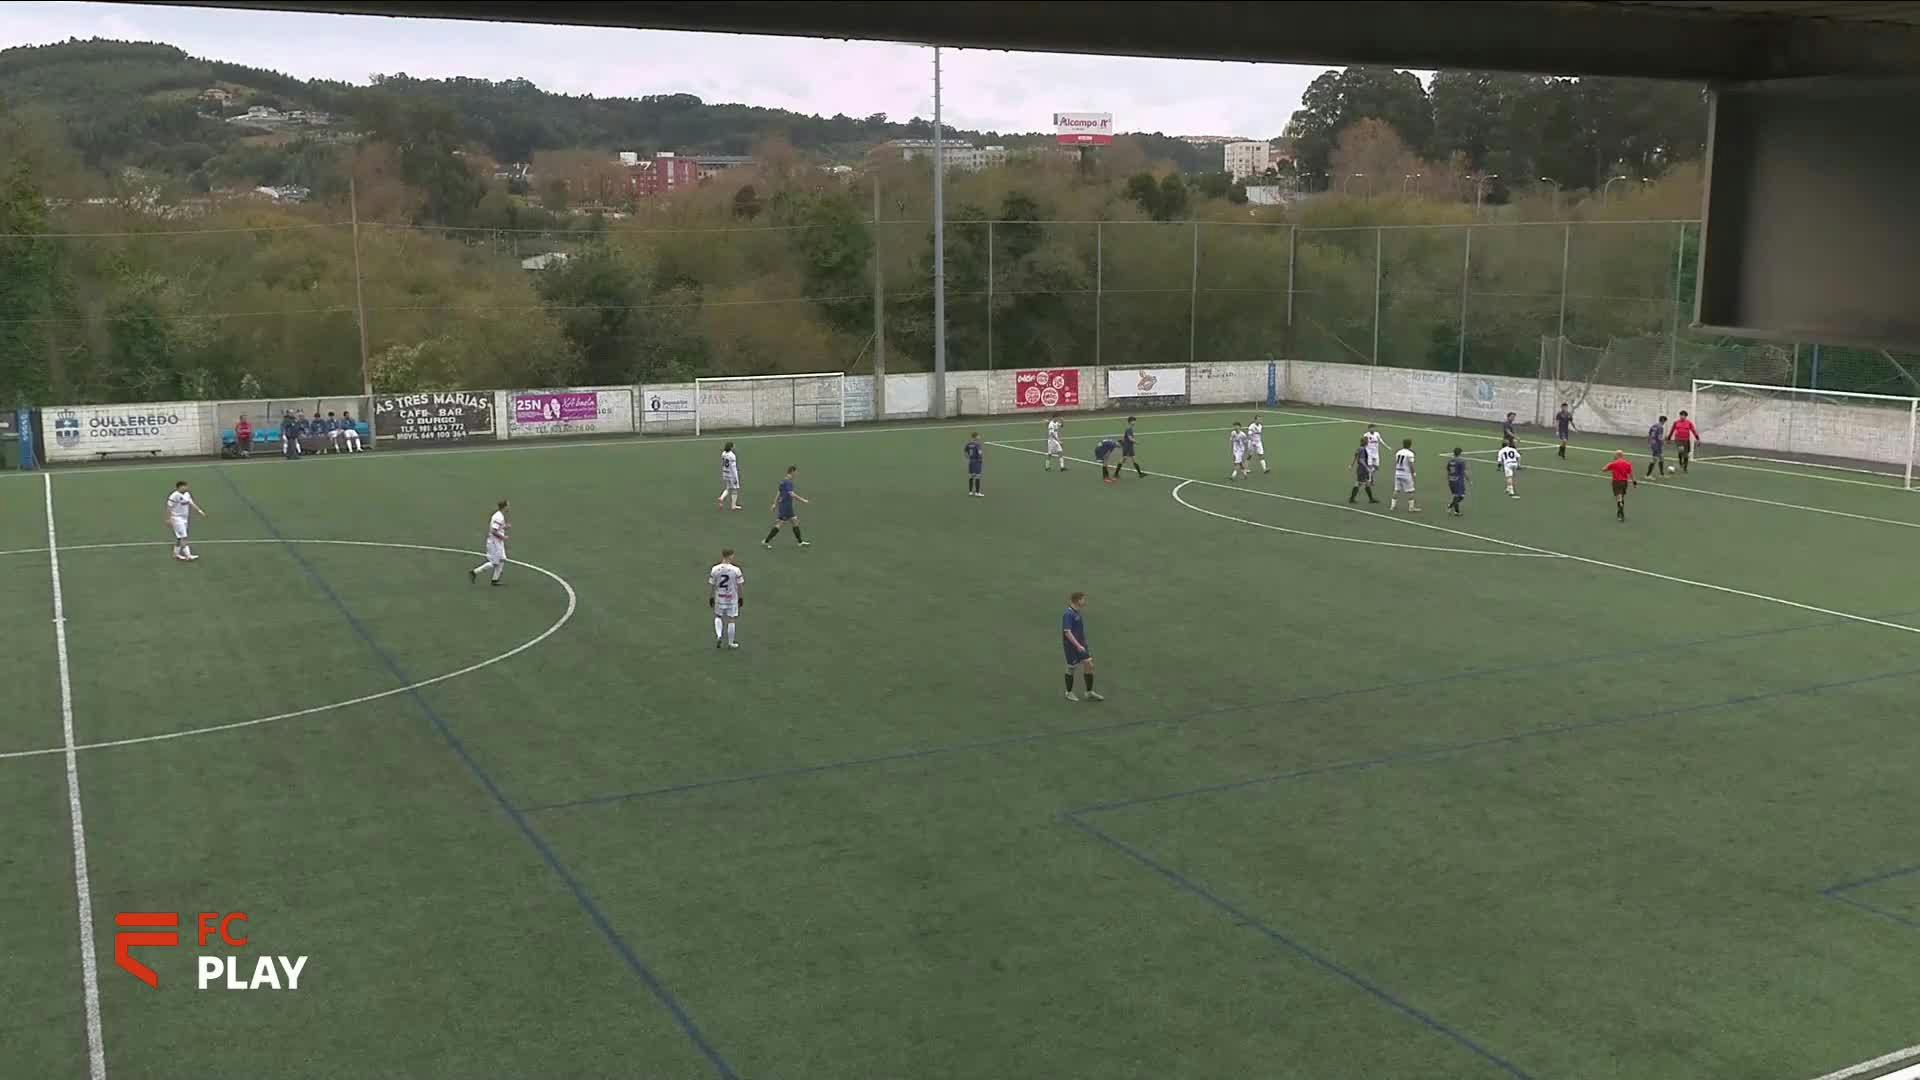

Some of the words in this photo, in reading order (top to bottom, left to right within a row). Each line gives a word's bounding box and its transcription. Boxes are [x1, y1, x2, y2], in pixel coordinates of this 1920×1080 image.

[1060, 116, 1098, 128] Alcampo
[376, 400, 394, 415] AS
[396, 394, 429, 409] TRES
[433, 393, 488, 409] MARIAS
[517, 399, 541, 411] 25N
[439, 408, 463, 417] BAR
[90, 427, 160, 438] CONCELLO
[1397, 454, 1405, 464] 11
[1503, 451, 1515, 460] 10
[719, 574, 730, 588] 2
